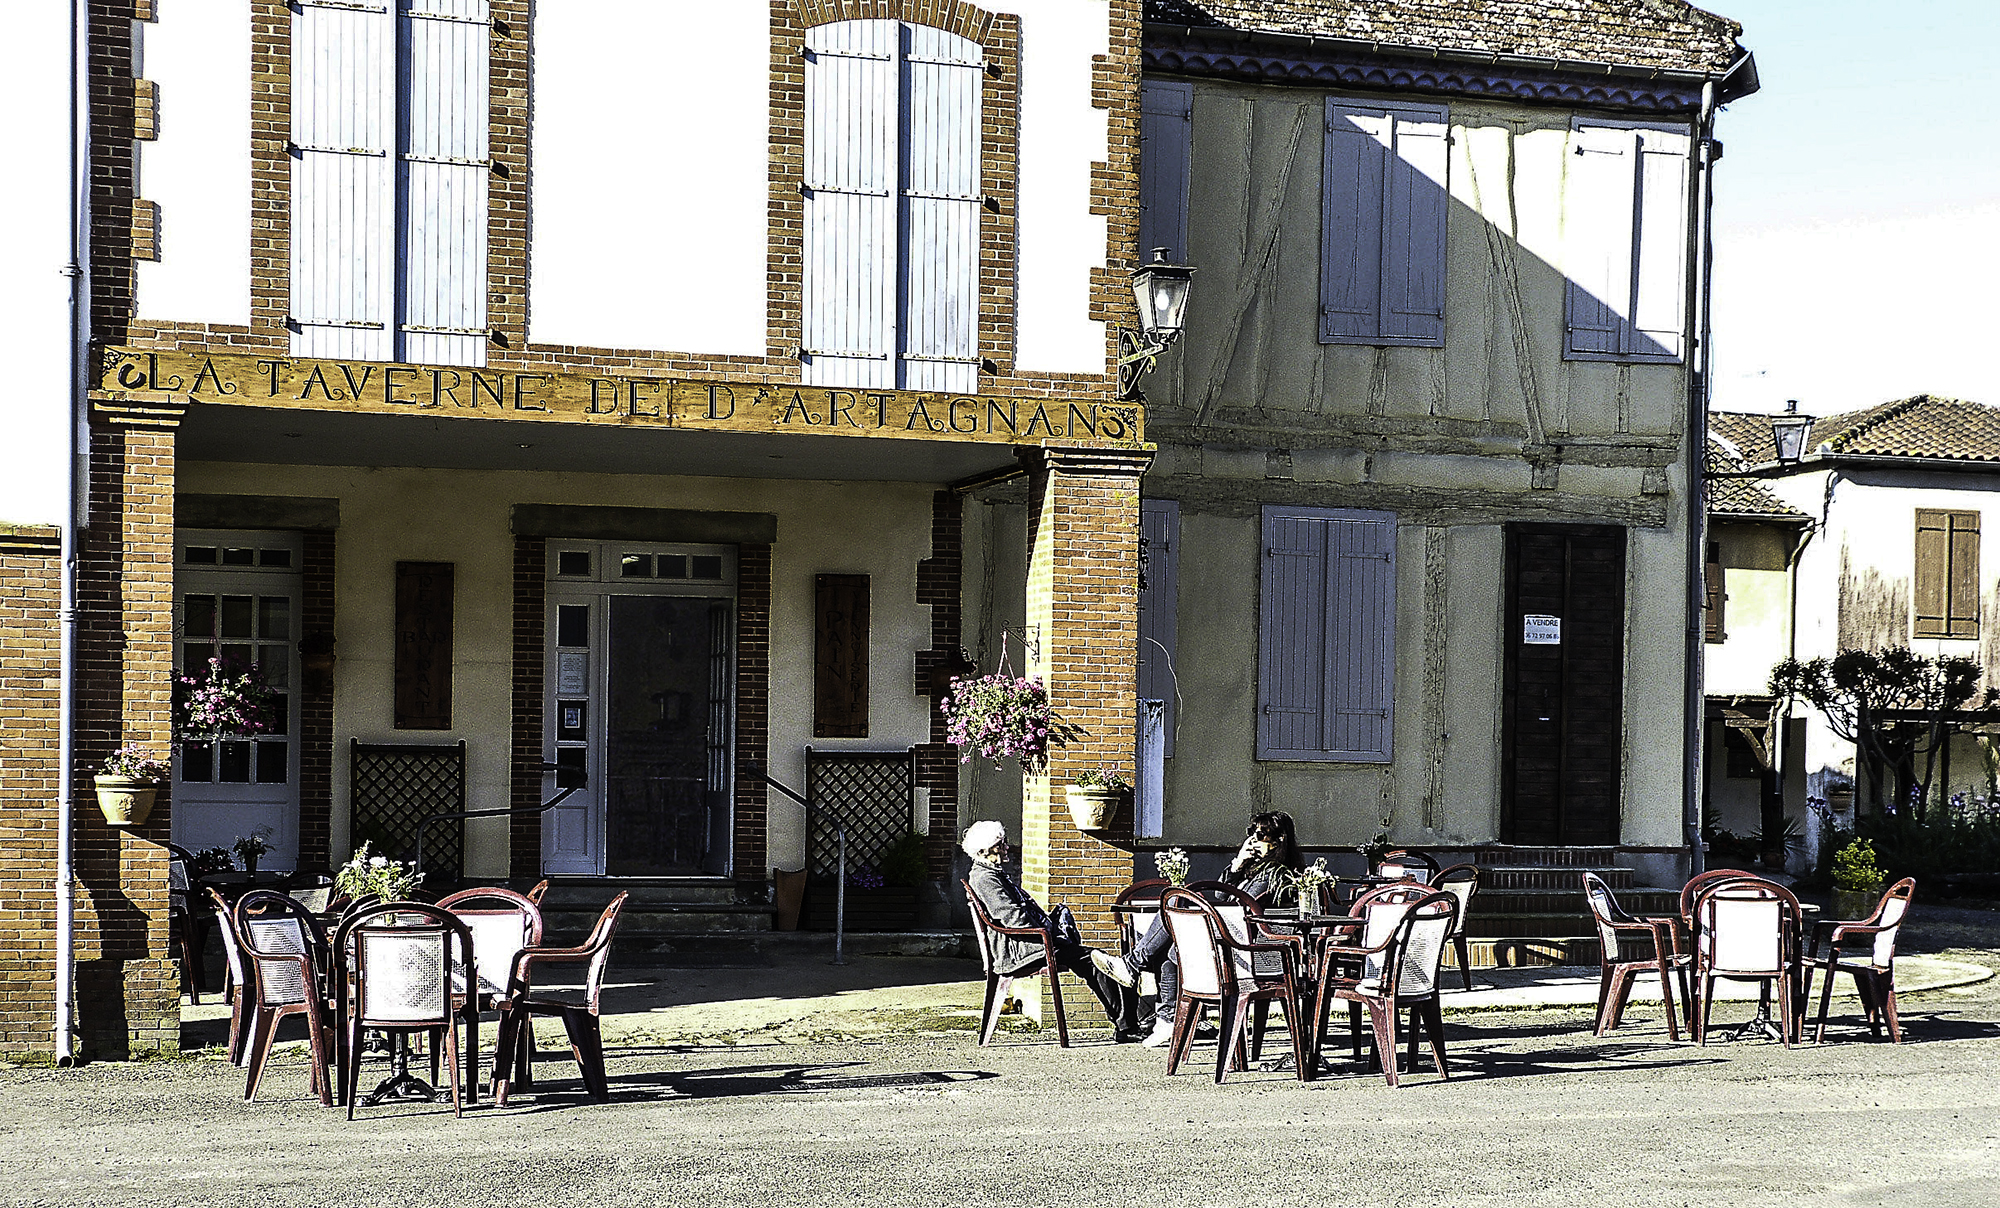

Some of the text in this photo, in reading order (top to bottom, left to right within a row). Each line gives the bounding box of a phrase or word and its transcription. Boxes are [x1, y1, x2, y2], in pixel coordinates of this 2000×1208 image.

[144, 352, 237, 395] LA
[257, 359, 547, 411] TAVERNE
[585, 378, 661, 417] DE
[400, 630, 447, 644] BAR
[1532, 619, 1559, 627] VENDRE
[826, 611, 844, 680] PAIN
